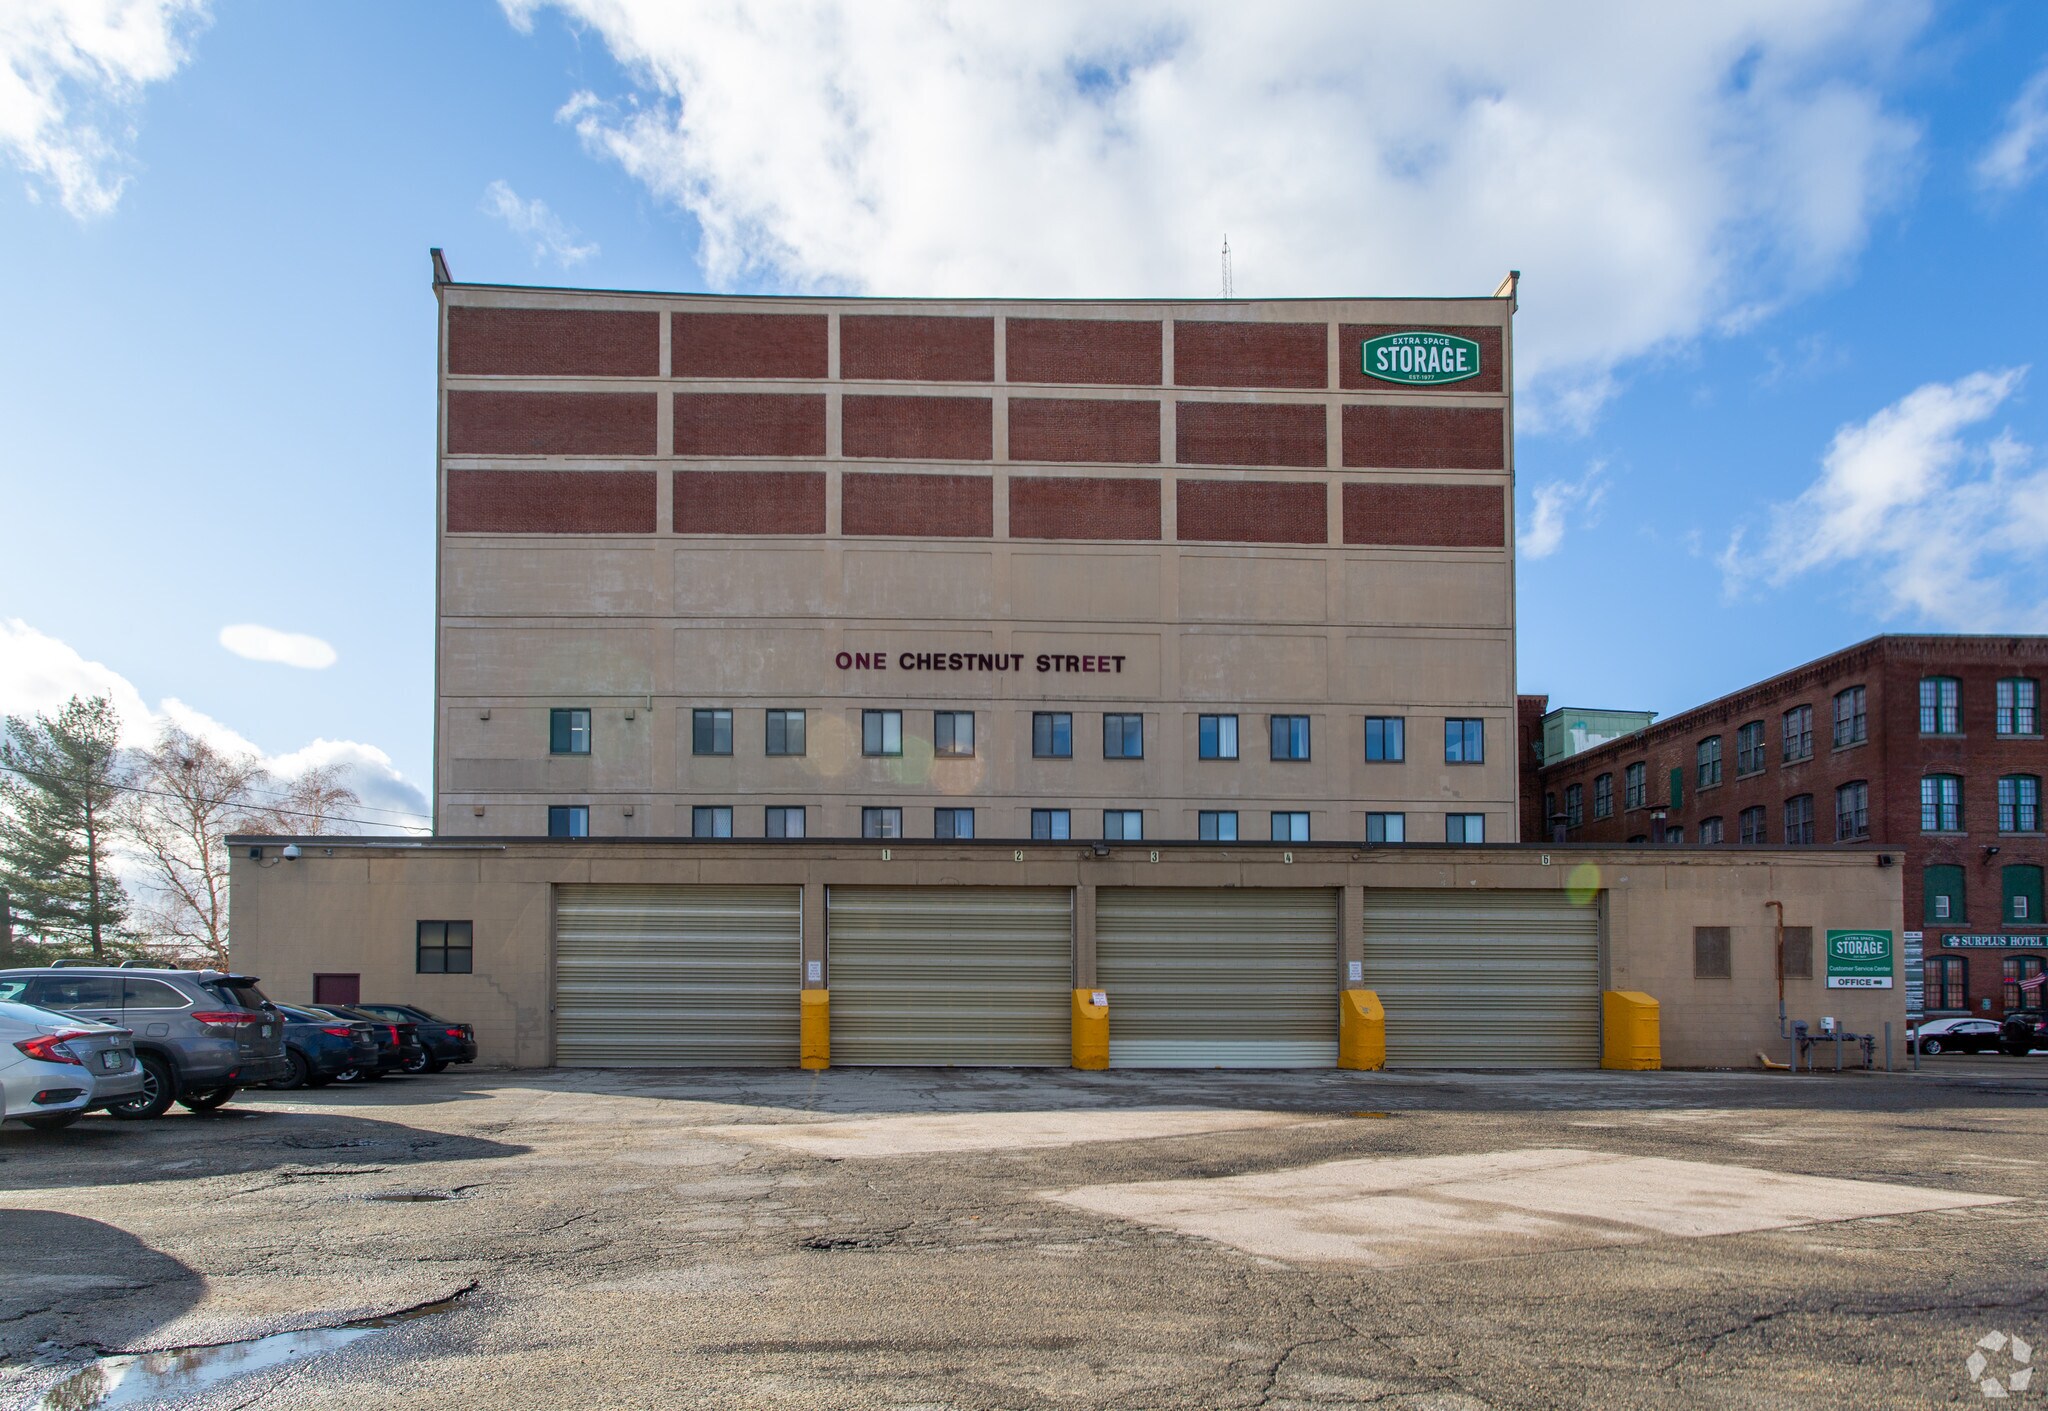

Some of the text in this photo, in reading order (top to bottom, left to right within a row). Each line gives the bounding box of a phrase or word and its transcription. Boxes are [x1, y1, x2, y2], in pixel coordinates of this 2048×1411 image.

[1392, 337, 1450, 346] EXTRA SPACE
[1376, 345, 1468, 373] STORAGE
[835, 651, 1126, 673] ONE CHESTNUT STREET
[1151, 851, 1158, 862] 3
[1543, 854, 1549, 865] 6
[1961, 936, 2007, 946] SURPLUS
[2010, 936, 2043, 946] HOTEL
[1836, 940, 1883, 955] STORAGE
[1838, 978, 1872, 986] OFFICE
